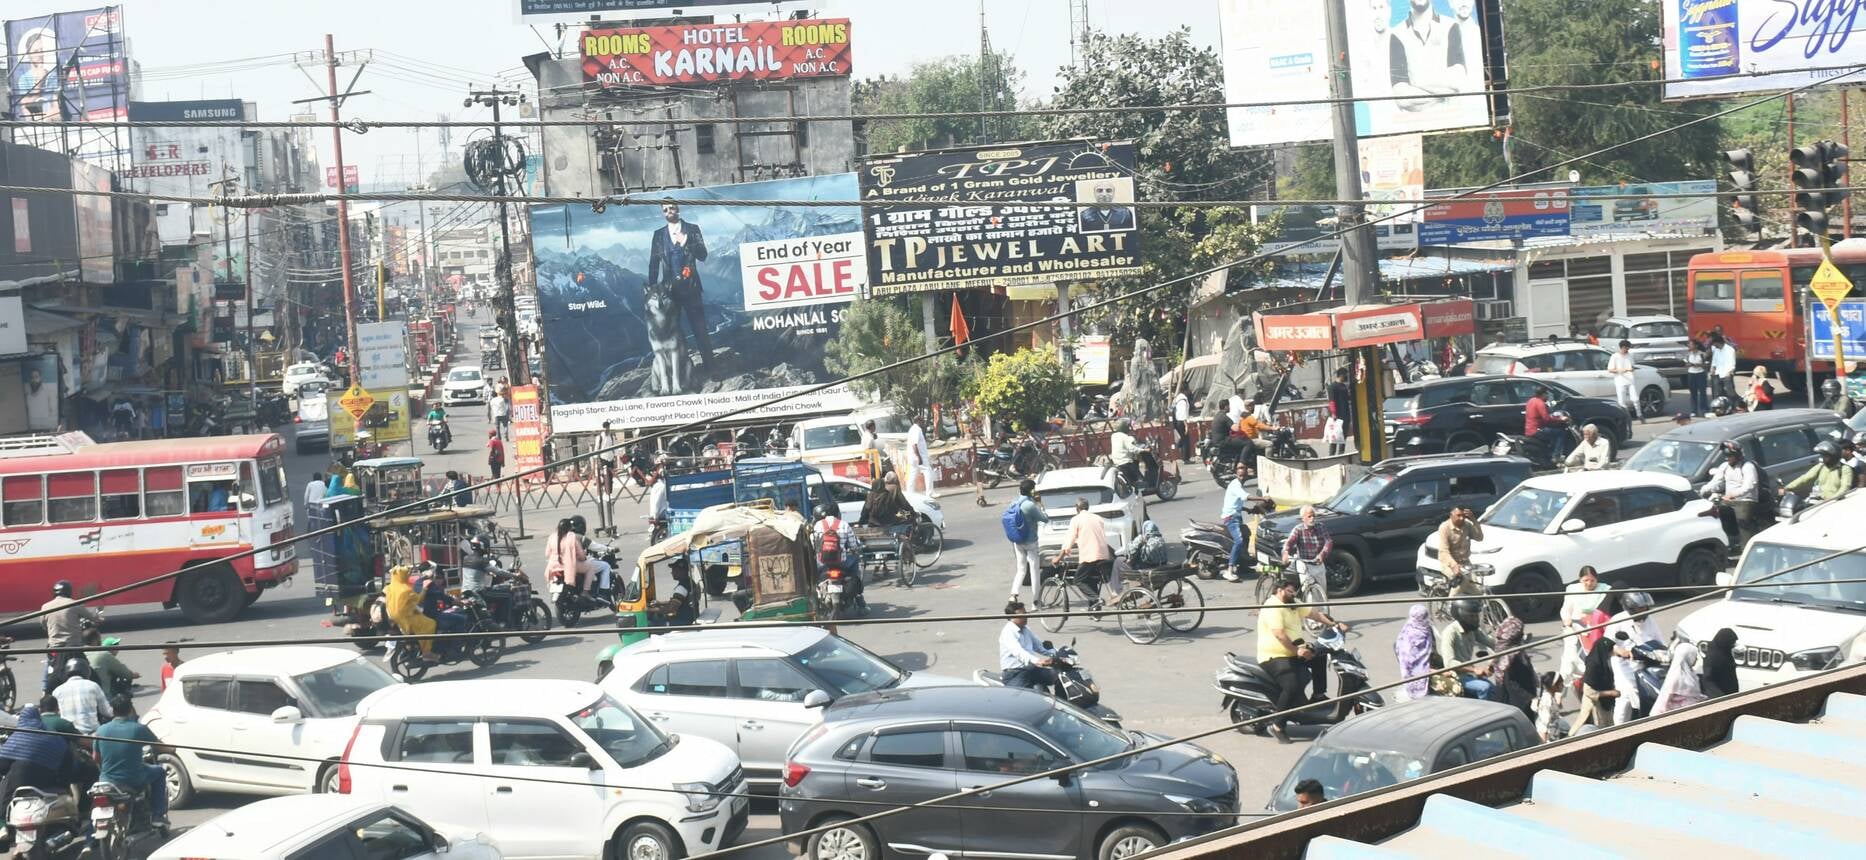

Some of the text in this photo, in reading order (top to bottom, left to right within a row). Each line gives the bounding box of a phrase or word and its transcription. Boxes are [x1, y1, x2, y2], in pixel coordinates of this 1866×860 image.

[684, 28, 749, 45] HOTEL
[782, 23, 847, 46] ROOMS
[585, 33, 652, 56] ROOMS
[654, 42, 782, 77] KARNAIL
[805, 47, 826, 59] A.C.
[102, 65, 120, 74] FUD
[609, 57, 630, 69] A.C.
[793, 60, 840, 73] NON A.C.
[597, 70, 644, 84] NON A.C.
[183, 108, 236, 119] SAMSUNG
[979, 151, 1000, 159] SINCE
[867, 170, 1120, 197] A Brand of 1 Gram Gold Jewellery
[966, 183, 1068, 201] Karanwal
[870, 213, 881, 225] 1
[887, 209, 933, 224] ग्राम
[965, 231, 983, 241] का
[986, 229, 1025, 240] सामान
[757, 239, 852, 261] End of Year
[1059, 232, 1128, 255] ART
[882, 254, 1133, 284] Manufacturer and Wholesaler
[757, 259, 854, 301] SALE
[965, 278, 995, 288] MEERUT
[568, 300, 607, 312] Stay Wild.
[753, 309, 849, 331] MOHANLAL SO
[1358, 322, 1380, 331] अमर
[514, 405, 539, 421] HOTEL
[552, 408, 585, 418] Flagship
[586, 406, 607, 414] Store:
[625, 404, 646, 412] Lane,
[646, 401, 675, 409] Fawara
[676, 398, 703, 406] Chowk
[707, 396, 731, 405] Noida
[735, 394, 752, 402] Mall
[753, 393, 761, 401] of
[762, 392, 781, 400] India
[629, 412, 673, 424] Connaught
[674, 411, 696, 419] Place
[760, 403, 794, 413] Chandni
[795, 401, 823, 409] Chowk
